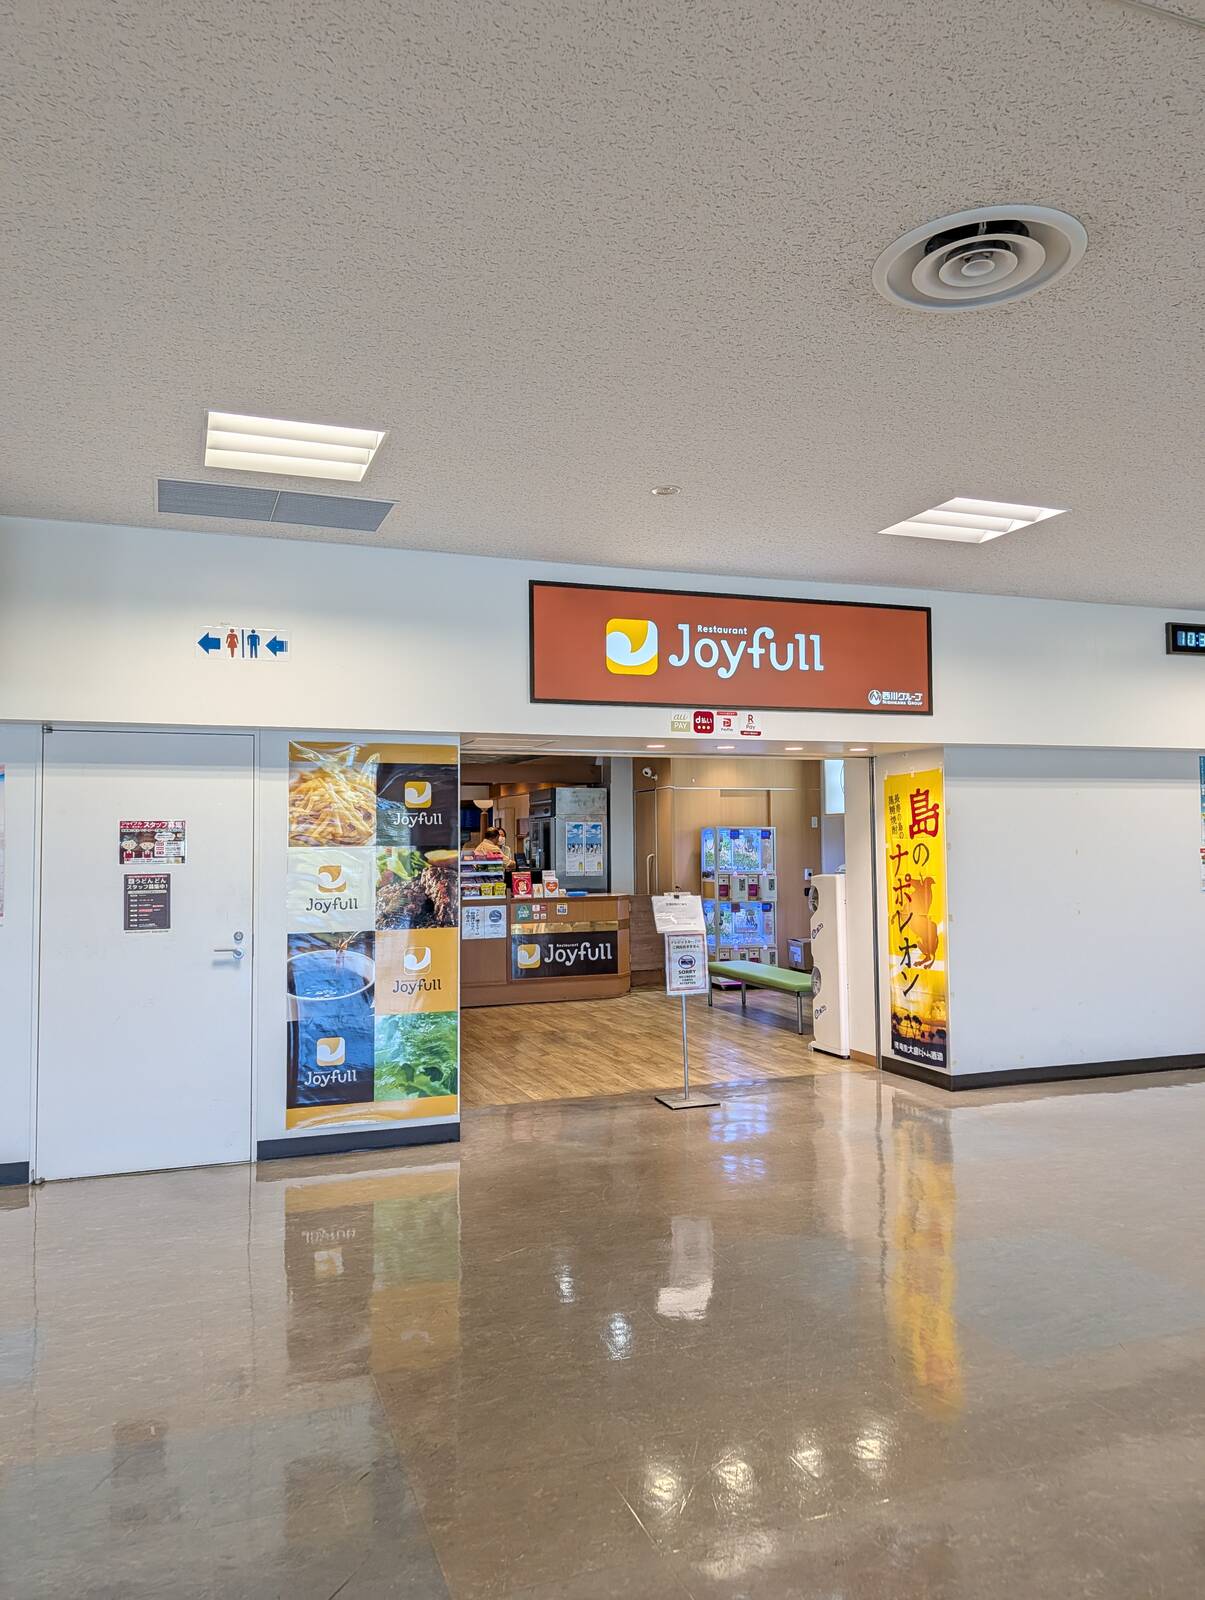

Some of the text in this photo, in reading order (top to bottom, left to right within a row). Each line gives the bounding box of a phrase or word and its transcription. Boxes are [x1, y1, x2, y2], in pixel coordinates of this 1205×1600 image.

[697, 624, 748, 635] Restaurant
[668, 623, 825, 679] Joyfull
[882, 691, 923, 701] 西川グループ
[695, 715, 713, 724] d払い
[393, 811, 443, 827] Joyfull
[306, 897, 358, 914] Joyfull
[544, 942, 613, 966] Joyfull
[393, 978, 442, 995] Joyfull
[304, 1069, 358, 1087] Joyfull
